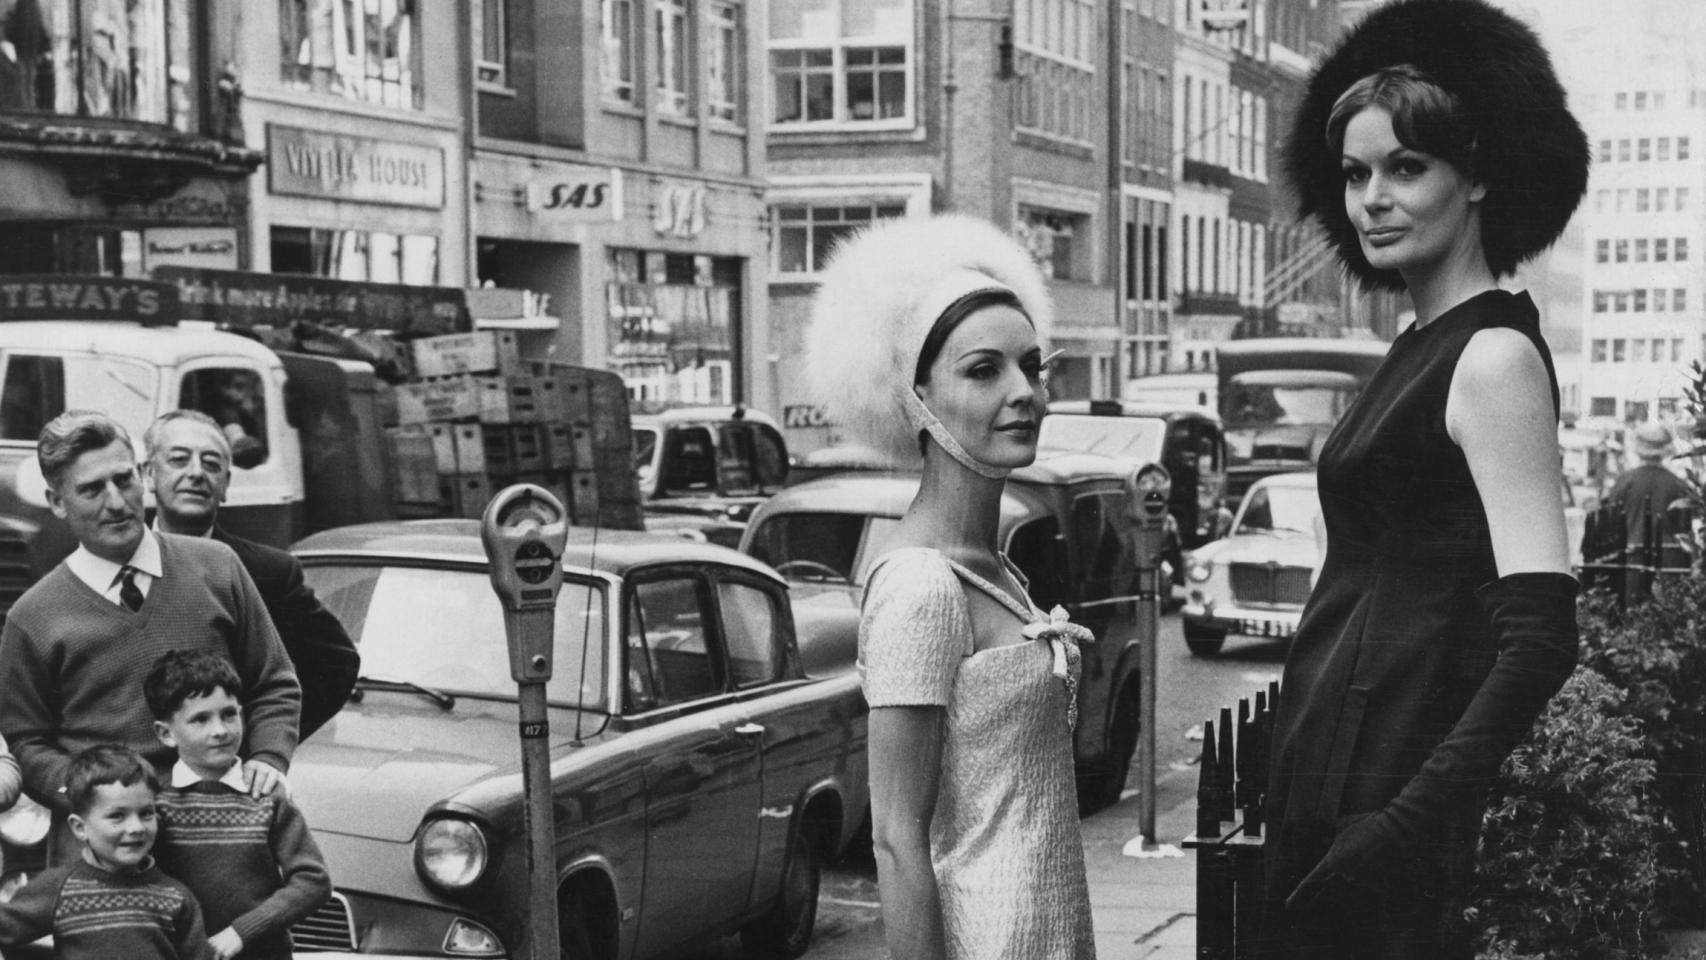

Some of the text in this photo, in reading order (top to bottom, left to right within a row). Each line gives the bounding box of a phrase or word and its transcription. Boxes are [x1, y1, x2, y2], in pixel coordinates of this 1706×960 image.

[368, 153, 428, 189] HOUSE
[542, 183, 610, 209] SAS
[1, 283, 160, 315] TEWAY'S
